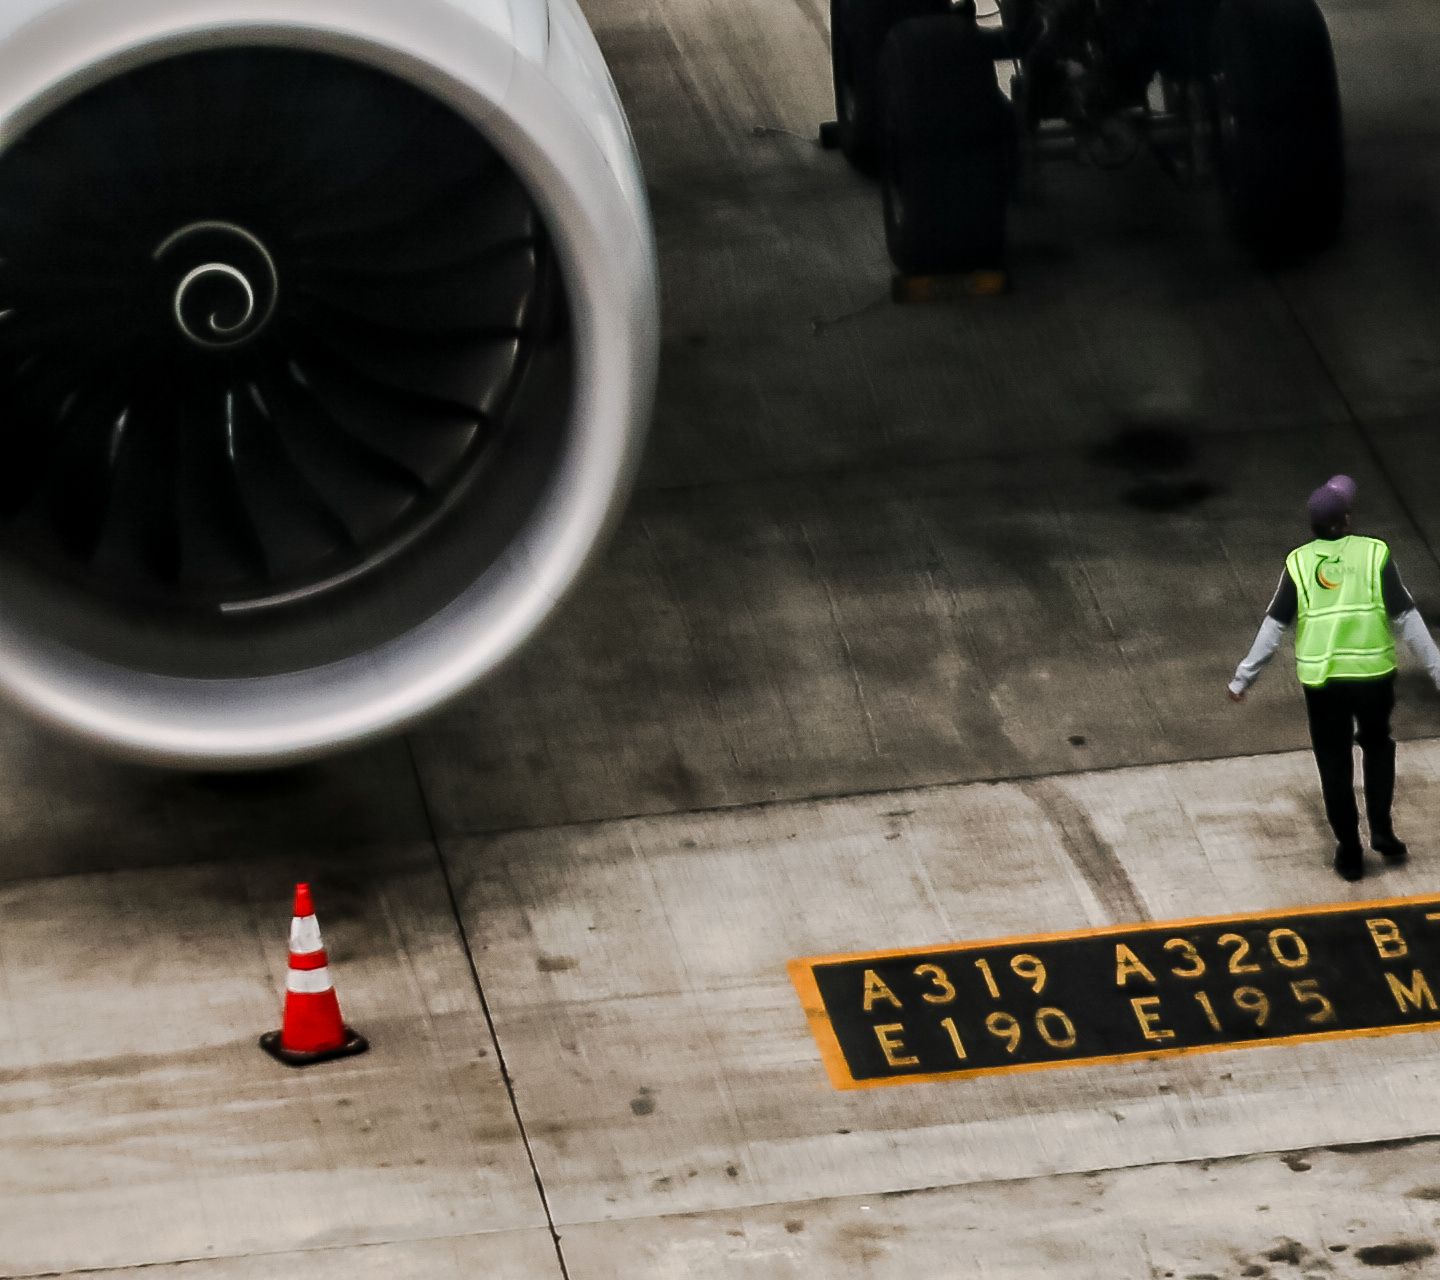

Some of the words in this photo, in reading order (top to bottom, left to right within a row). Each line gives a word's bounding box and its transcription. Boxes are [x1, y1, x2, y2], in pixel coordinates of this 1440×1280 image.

[863, 953, 1046, 1012] A319
[1115, 928, 1310, 986] A320
[874, 1005, 1078, 1068] E190
[1130, 979, 1336, 1041] E195
